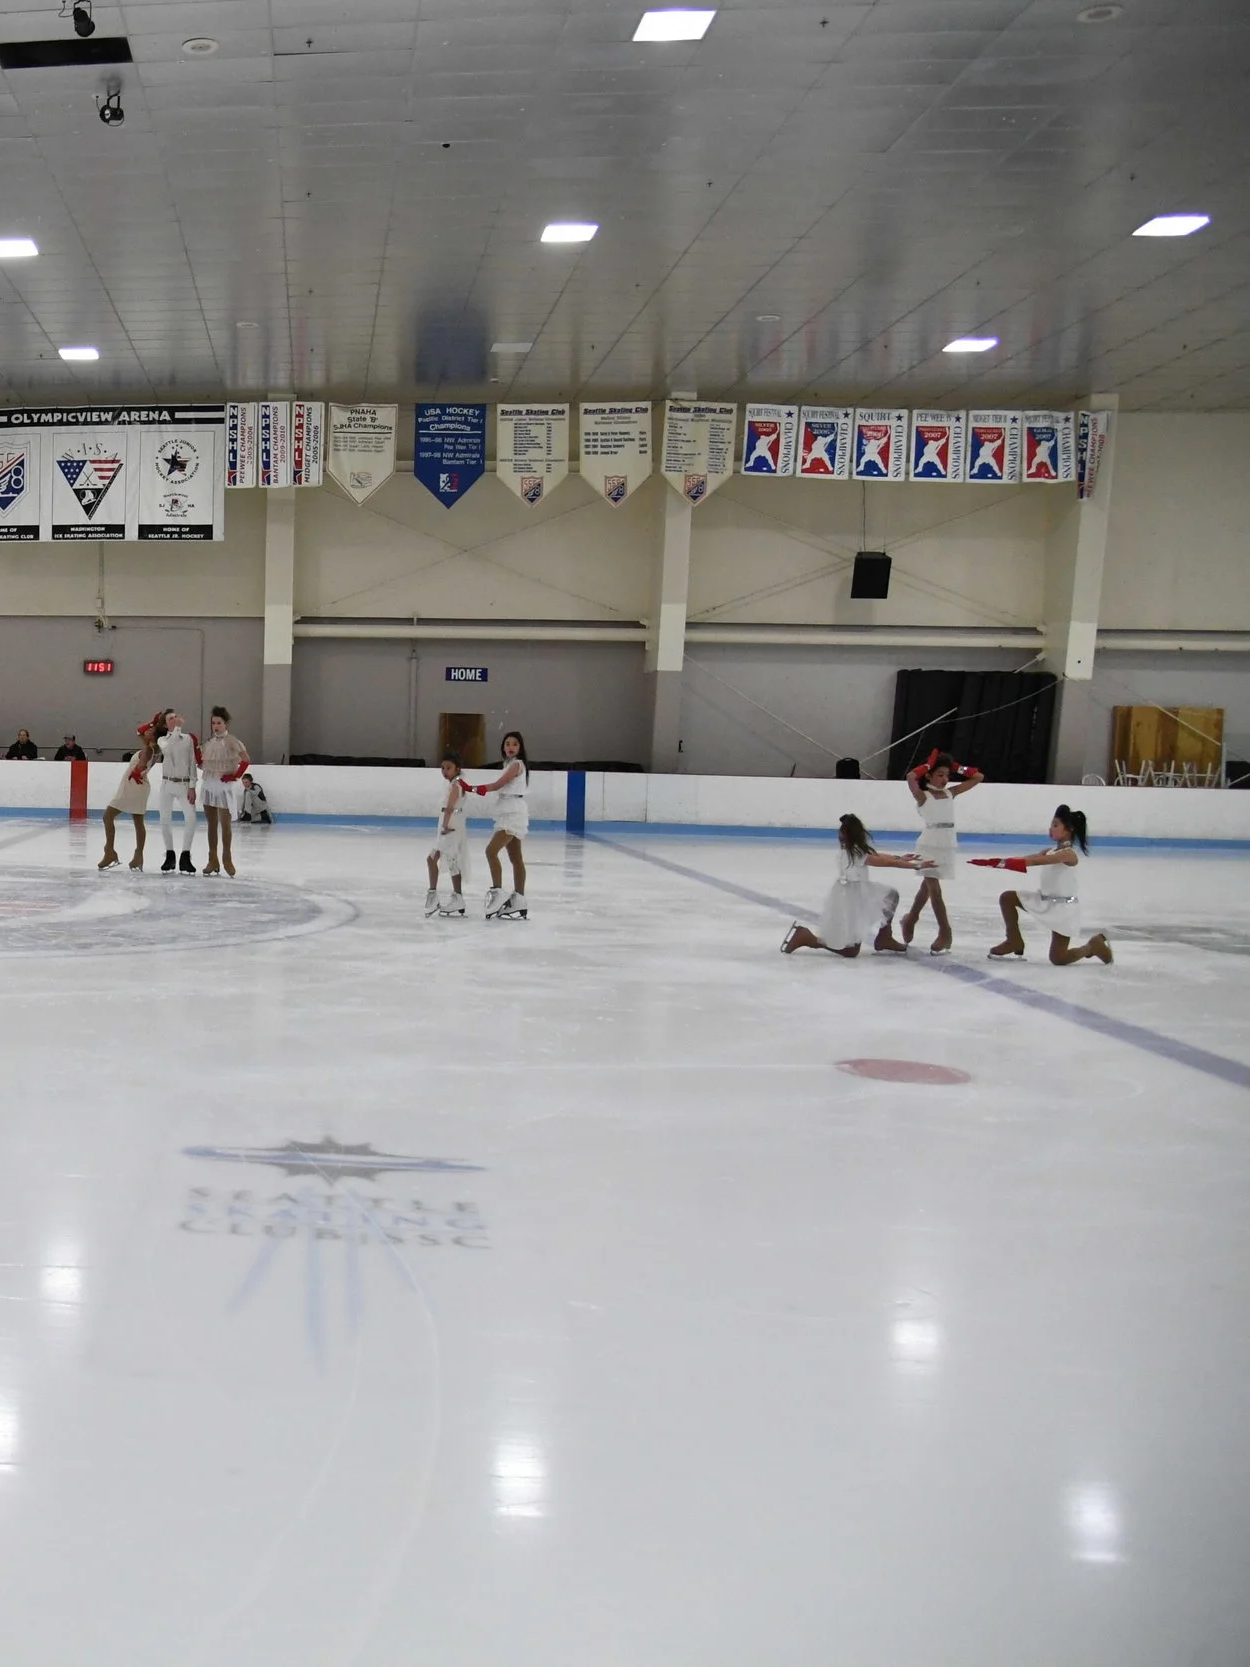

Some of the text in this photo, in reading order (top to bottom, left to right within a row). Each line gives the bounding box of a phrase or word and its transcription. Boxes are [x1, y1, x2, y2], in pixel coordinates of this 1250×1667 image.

[11, 411, 171, 423] OLYMPICVIEW ARENA
[350, 408, 377, 416] PNAHA
[424, 408, 480, 416] USA HOCKEY
[859, 413, 892, 422] SQUIRT
[916, 414, 945, 422] PEE WEE
[262, 407, 270, 461] NPSHL
[296, 406, 304, 460] NPSHL
[430, 422, 470, 431] Champions
[158, 440, 197, 453] SEATTLE JUNIOR
[782, 422, 793, 474] CHAMPIONS
[836, 422, 848, 476] CHAMPIONS
[893, 425, 904, 478] CHAMPIONS
[952, 426, 962, 479] CHAMPIONS
[1008, 428, 1019, 481] CHAMPIONS
[1062, 428, 1071, 478] CHAMPIONS
[1078, 416, 1088, 472] NPSHL
[155, 462, 199, 484] HOCKEY ASSOCIATION
[451, 669, 482, 680] HOME
[190, 1187, 477, 1212] SEATTLE
[178, 1220, 342, 1242] CLUB
